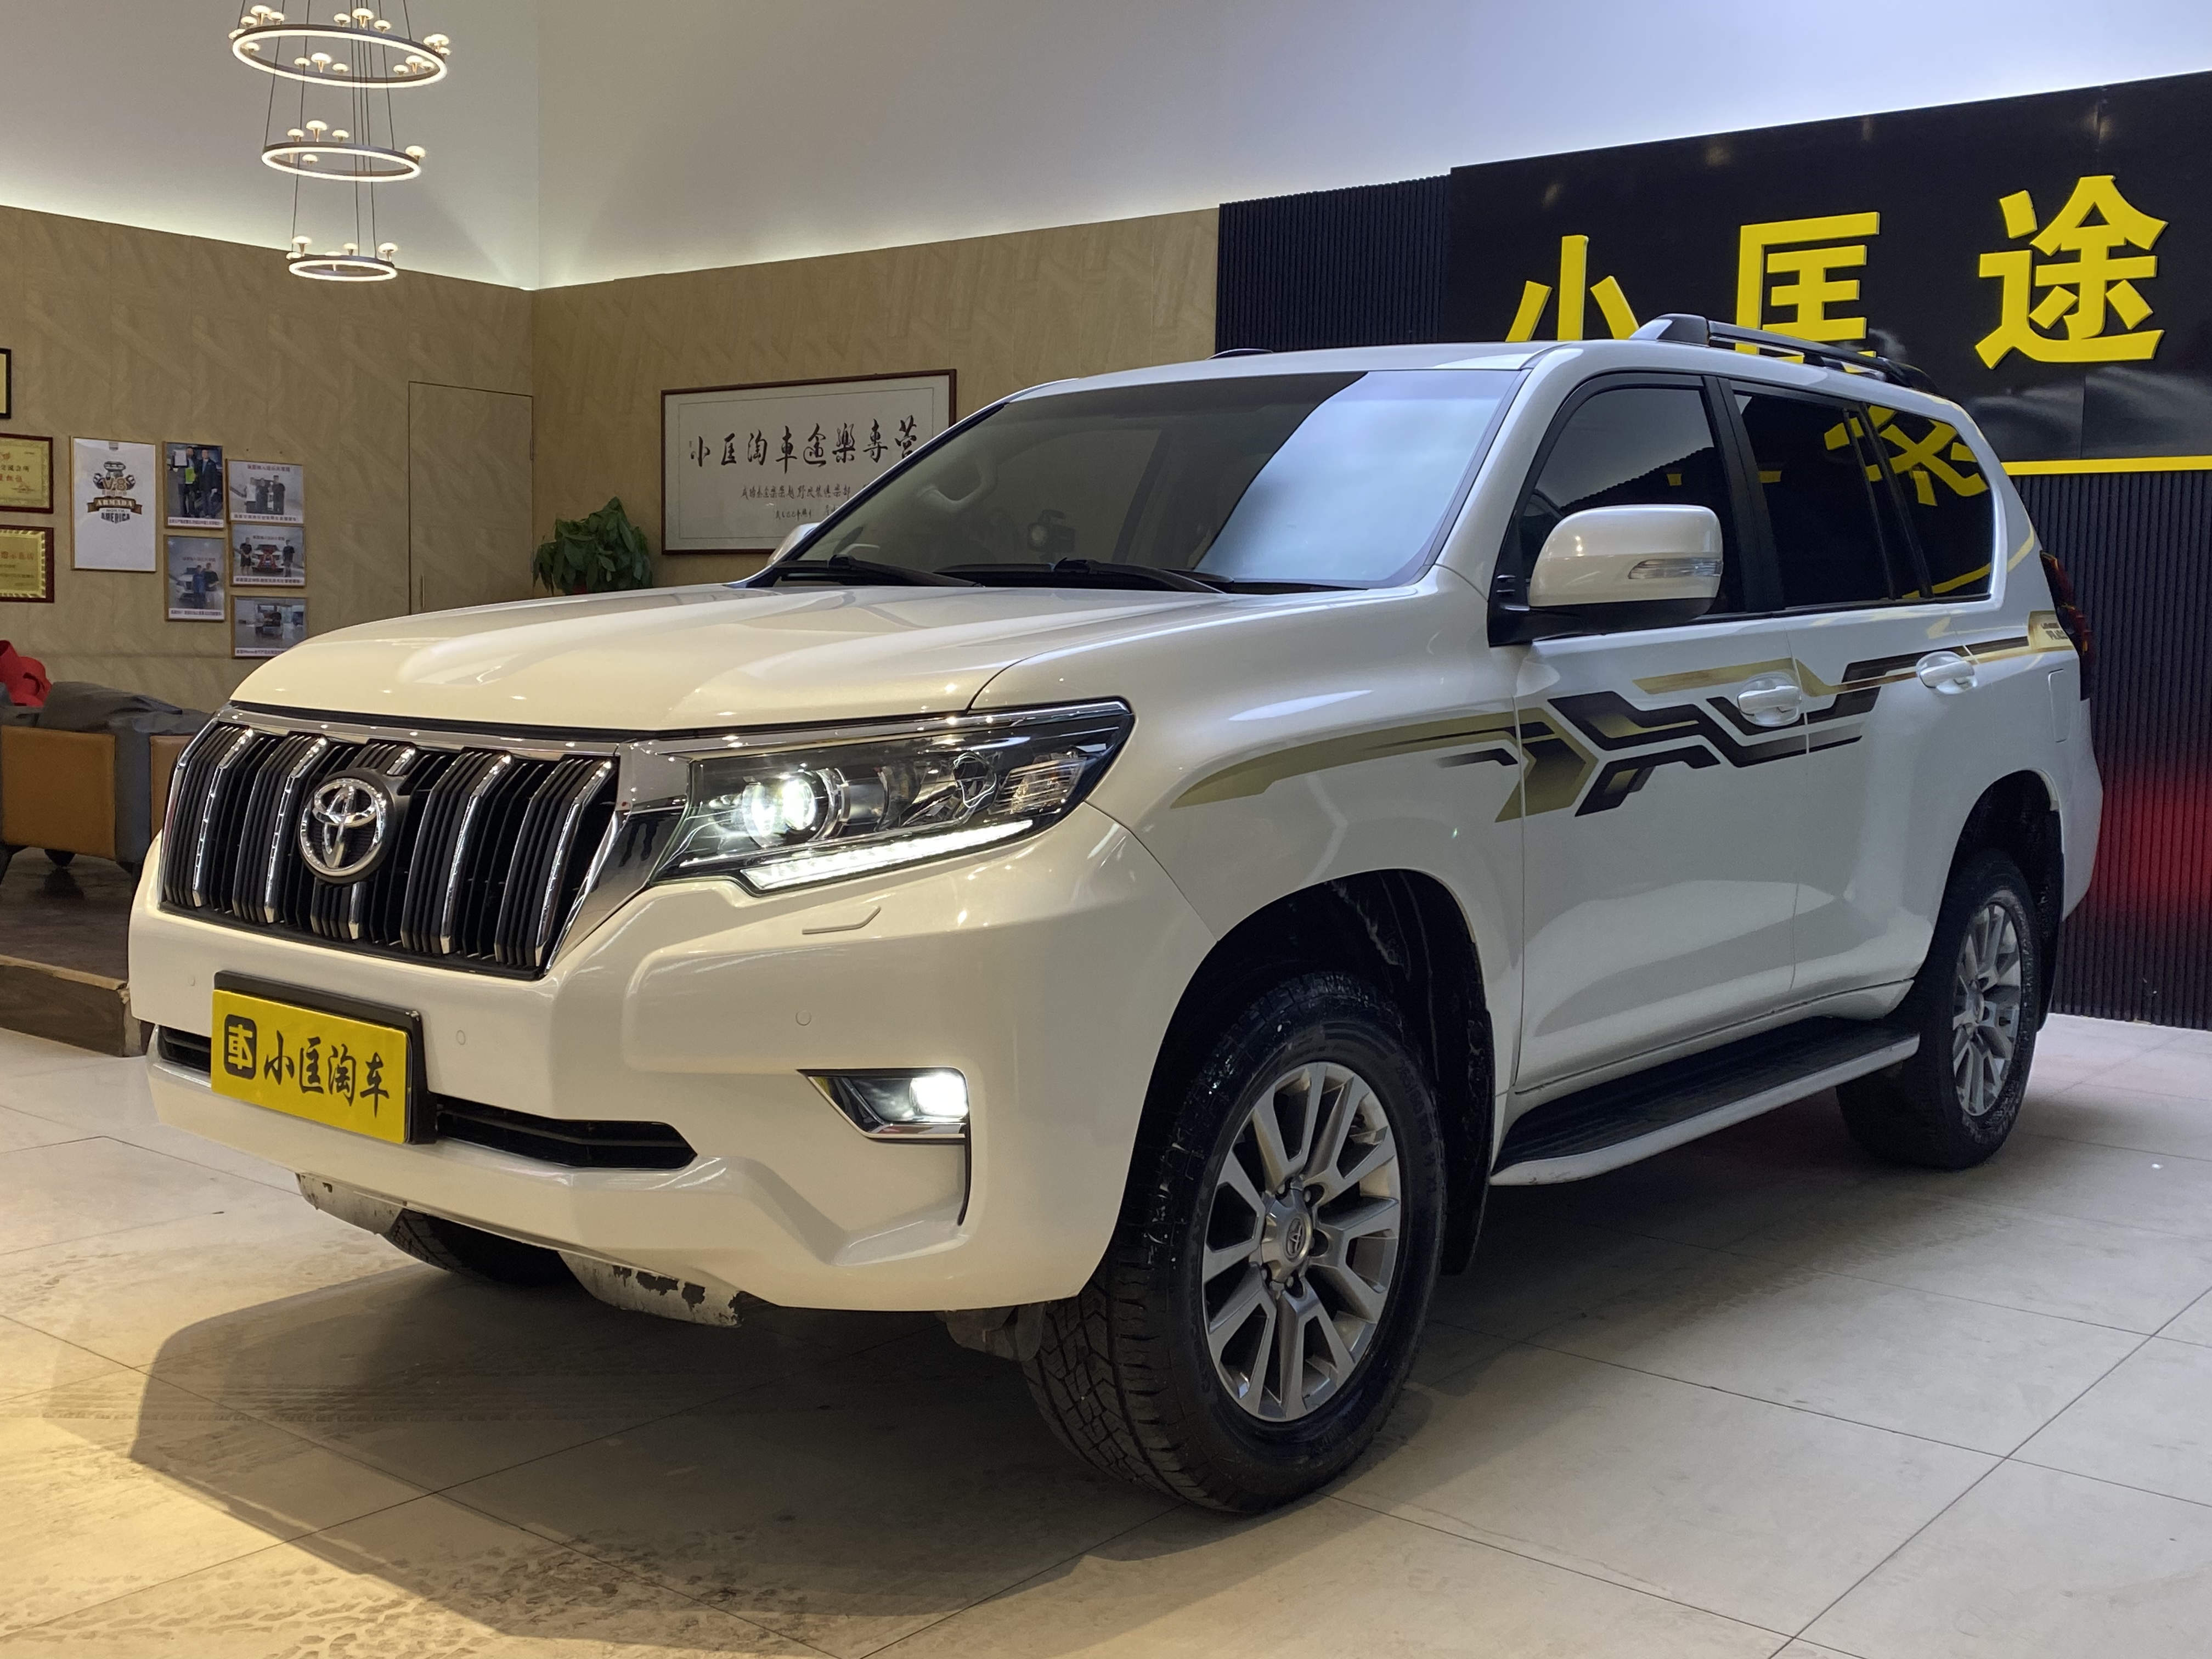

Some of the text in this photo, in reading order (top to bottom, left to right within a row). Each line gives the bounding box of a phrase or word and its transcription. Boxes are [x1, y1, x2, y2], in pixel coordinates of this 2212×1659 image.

[101, 513, 130, 523] AMERICA
[263, 1029, 391, 1119] 小匡淘车
